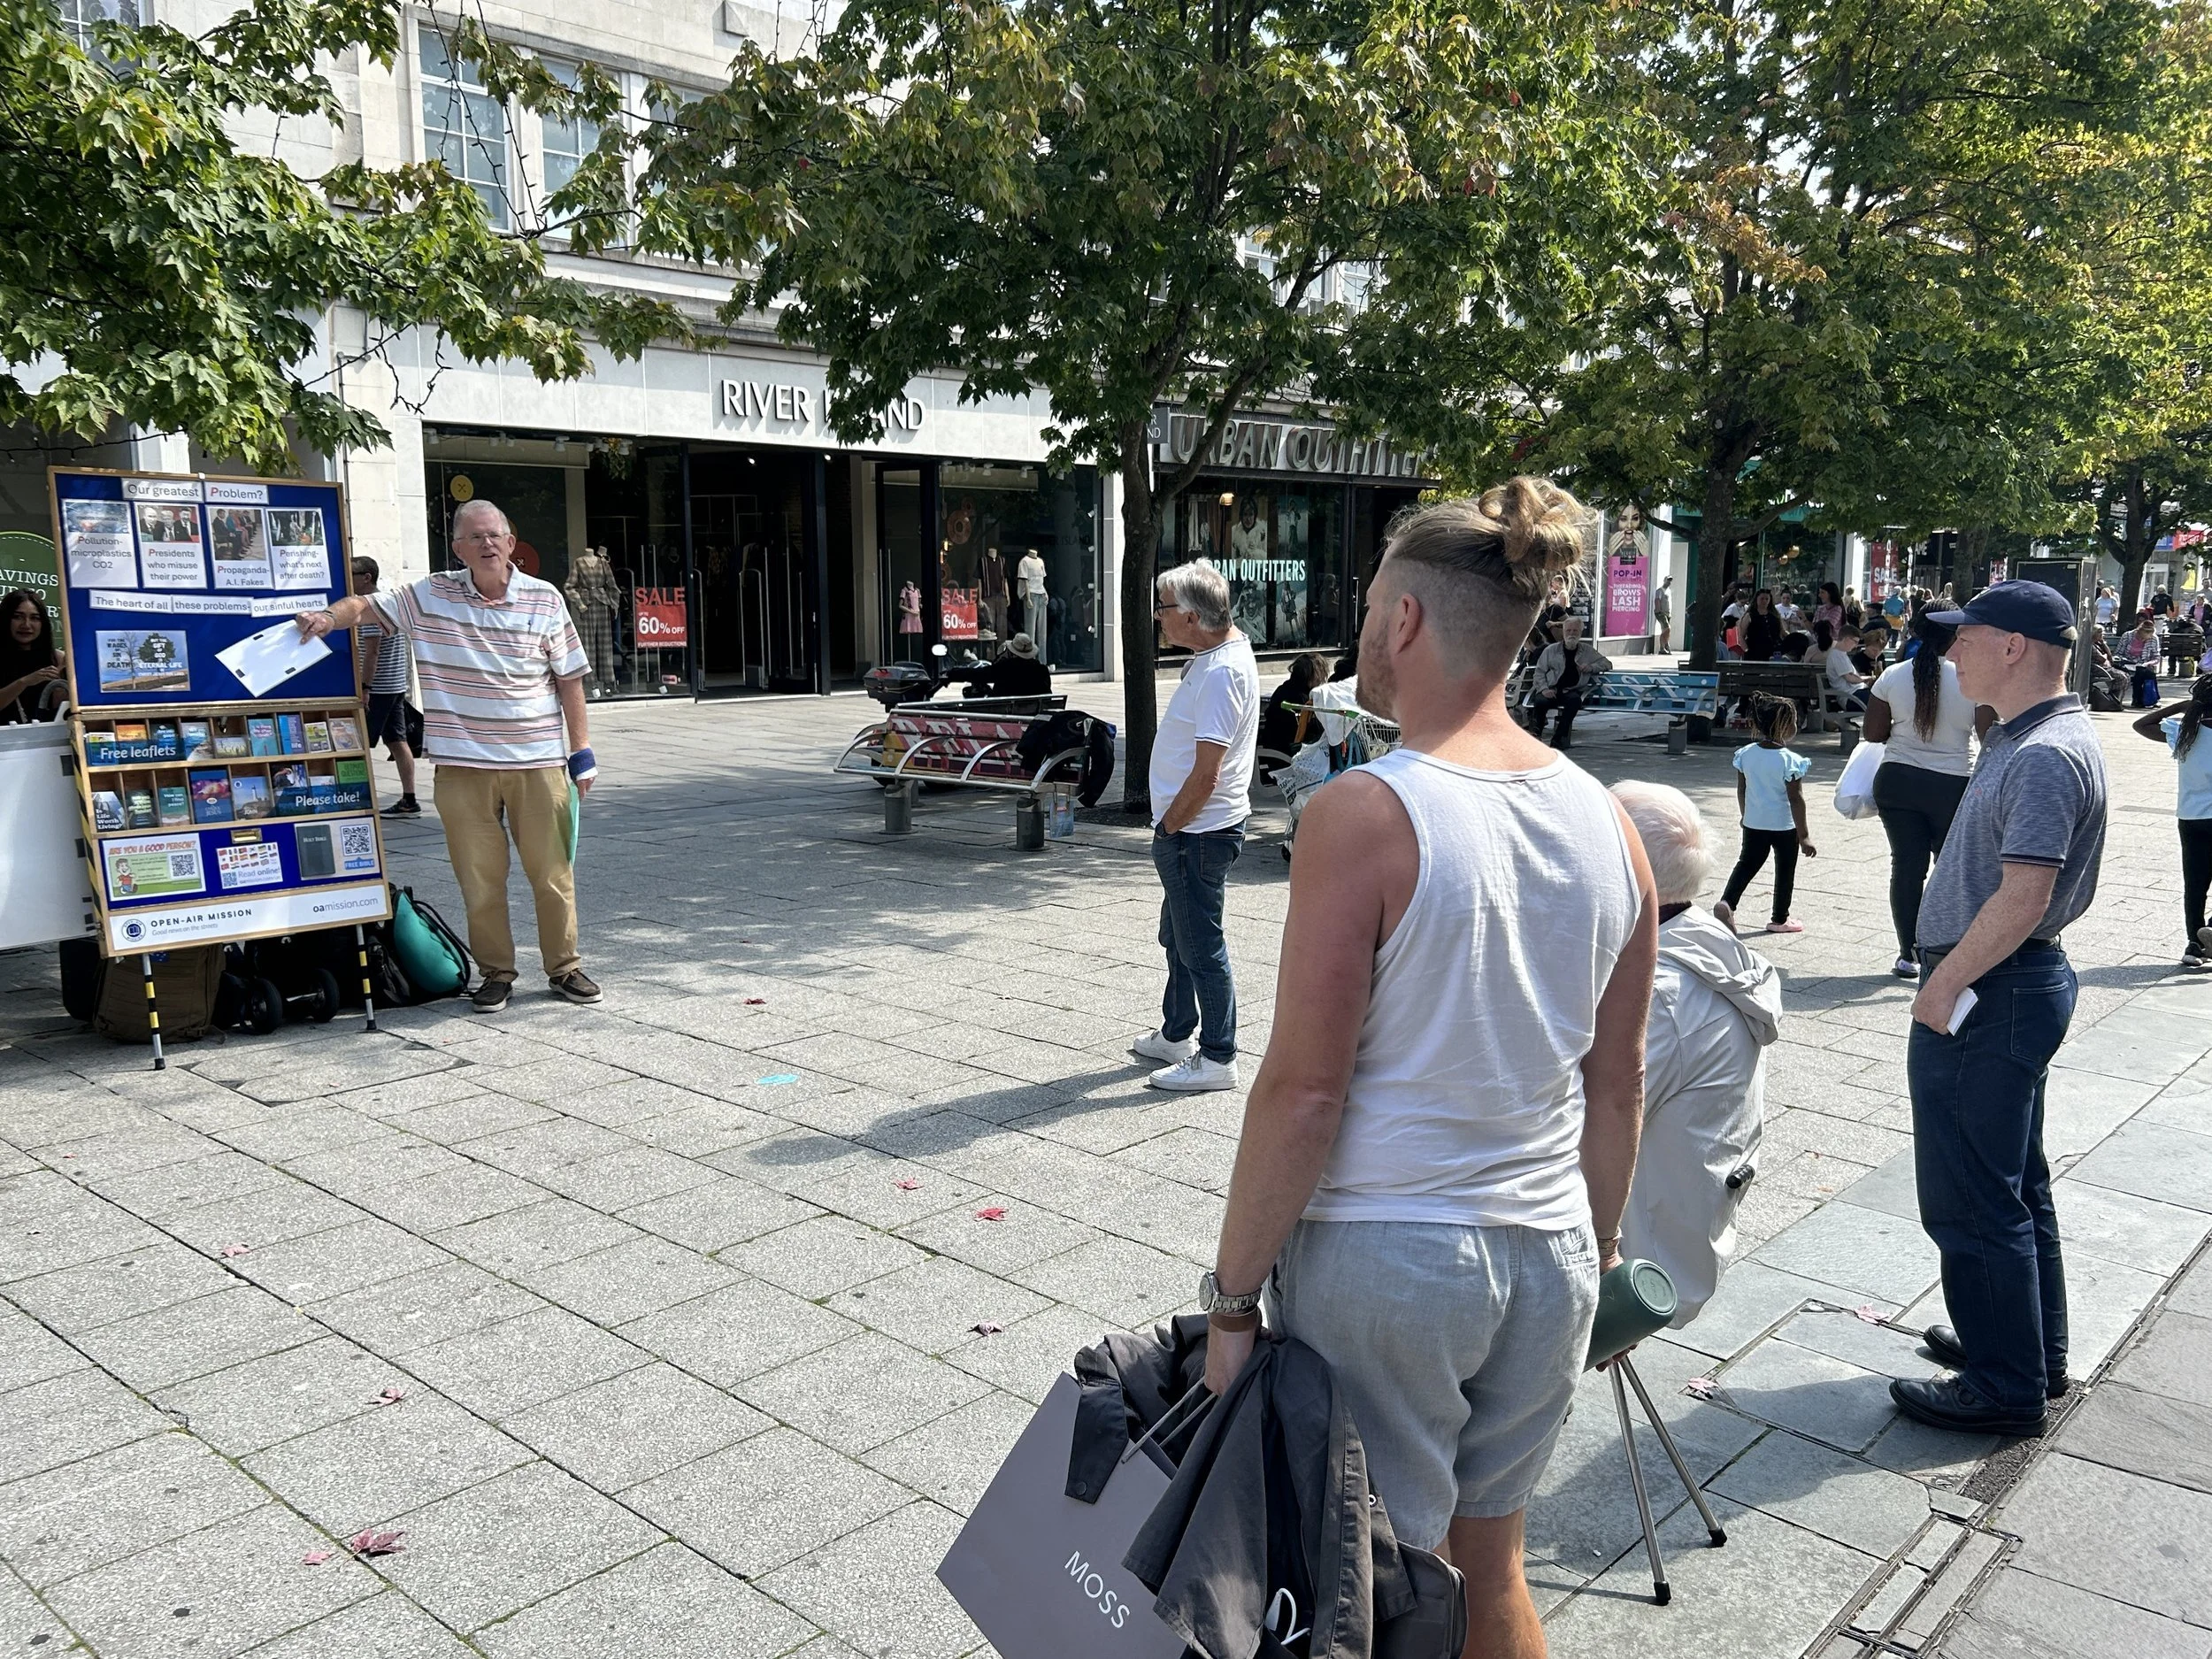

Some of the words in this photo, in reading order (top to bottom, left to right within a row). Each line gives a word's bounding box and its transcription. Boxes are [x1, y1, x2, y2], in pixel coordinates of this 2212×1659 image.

[722, 379, 811, 421] RIVER
[128, 484, 150, 495] Our
[153, 487, 199, 497] greatest
[211, 487, 263, 499] Problem?
[78, 536, 123, 546] Pollution-
[71, 549, 132, 558] microplastics
[149, 549, 195, 557] Presidents
[280, 549, 319, 558] Perishing-
[92, 560, 113, 569] CO2
[218, 565, 270, 575] Propaganda-
[1240, 559, 1306, 581] OUTFITTERS
[96, 596, 114, 606] The
[116, 598, 142, 609] heart
[144, 599, 155, 609] of
[157, 600, 168, 611] all
[175, 601, 201, 611] these
[204, 602, 251, 611] problems-
[270, 601, 294, 611] sinful
[296, 600, 326, 609] hearts.
[635, 588, 686, 605] SALE
[942, 588, 978, 604] SALE
[1612, 596, 1641, 606] LASH
[639, 617, 671, 634] 60%
[943, 614, 965, 629] 60%
[100, 748, 128, 759] Free
[130, 745, 176, 758] leaflets
[296, 794, 331, 807] Please
[333, 791, 360, 803] take!
[144, 843, 165, 852] GOOD
[165, 841, 196, 849] PERSON?
[313, 897, 379, 913] oamission.com
[151, 915, 204, 927] OPEN-AIR
[208, 909, 252, 921] MISSION
[1064, 1550, 1131, 1629] MOSS
